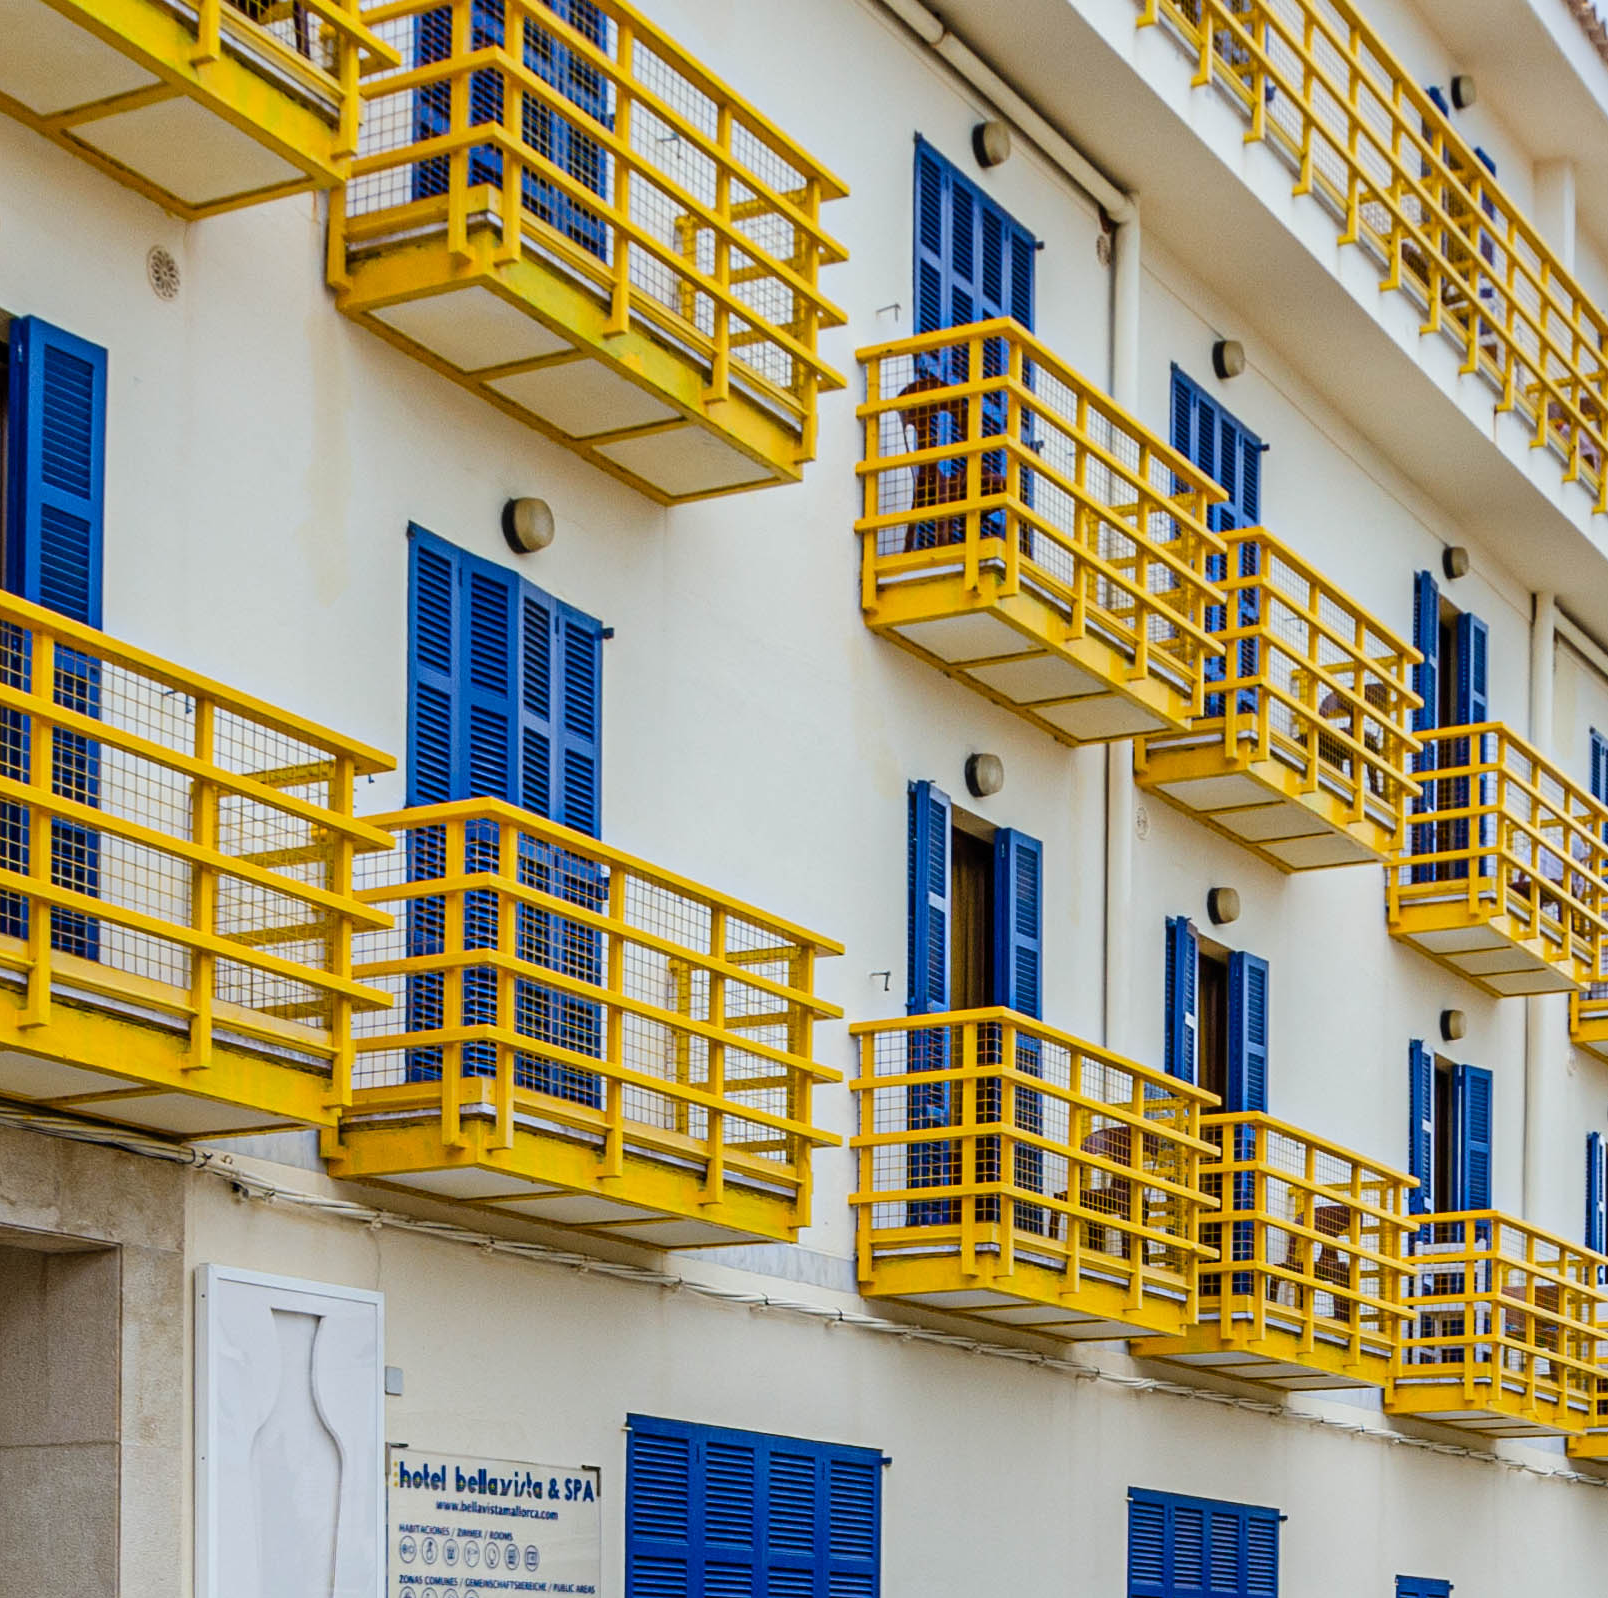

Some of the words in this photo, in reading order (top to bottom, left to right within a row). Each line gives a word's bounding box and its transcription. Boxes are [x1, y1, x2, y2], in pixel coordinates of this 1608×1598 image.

[399, 1461, 446, 1491] hotel
[455, 1466, 543, 1499] bellavista
[548, 1478, 560, 1500] &
[564, 1478, 594, 1502] SPA
[436, 1500, 559, 1520] www.bellavistamallorca.com
[399, 1574, 423, 1584] ZONAS
